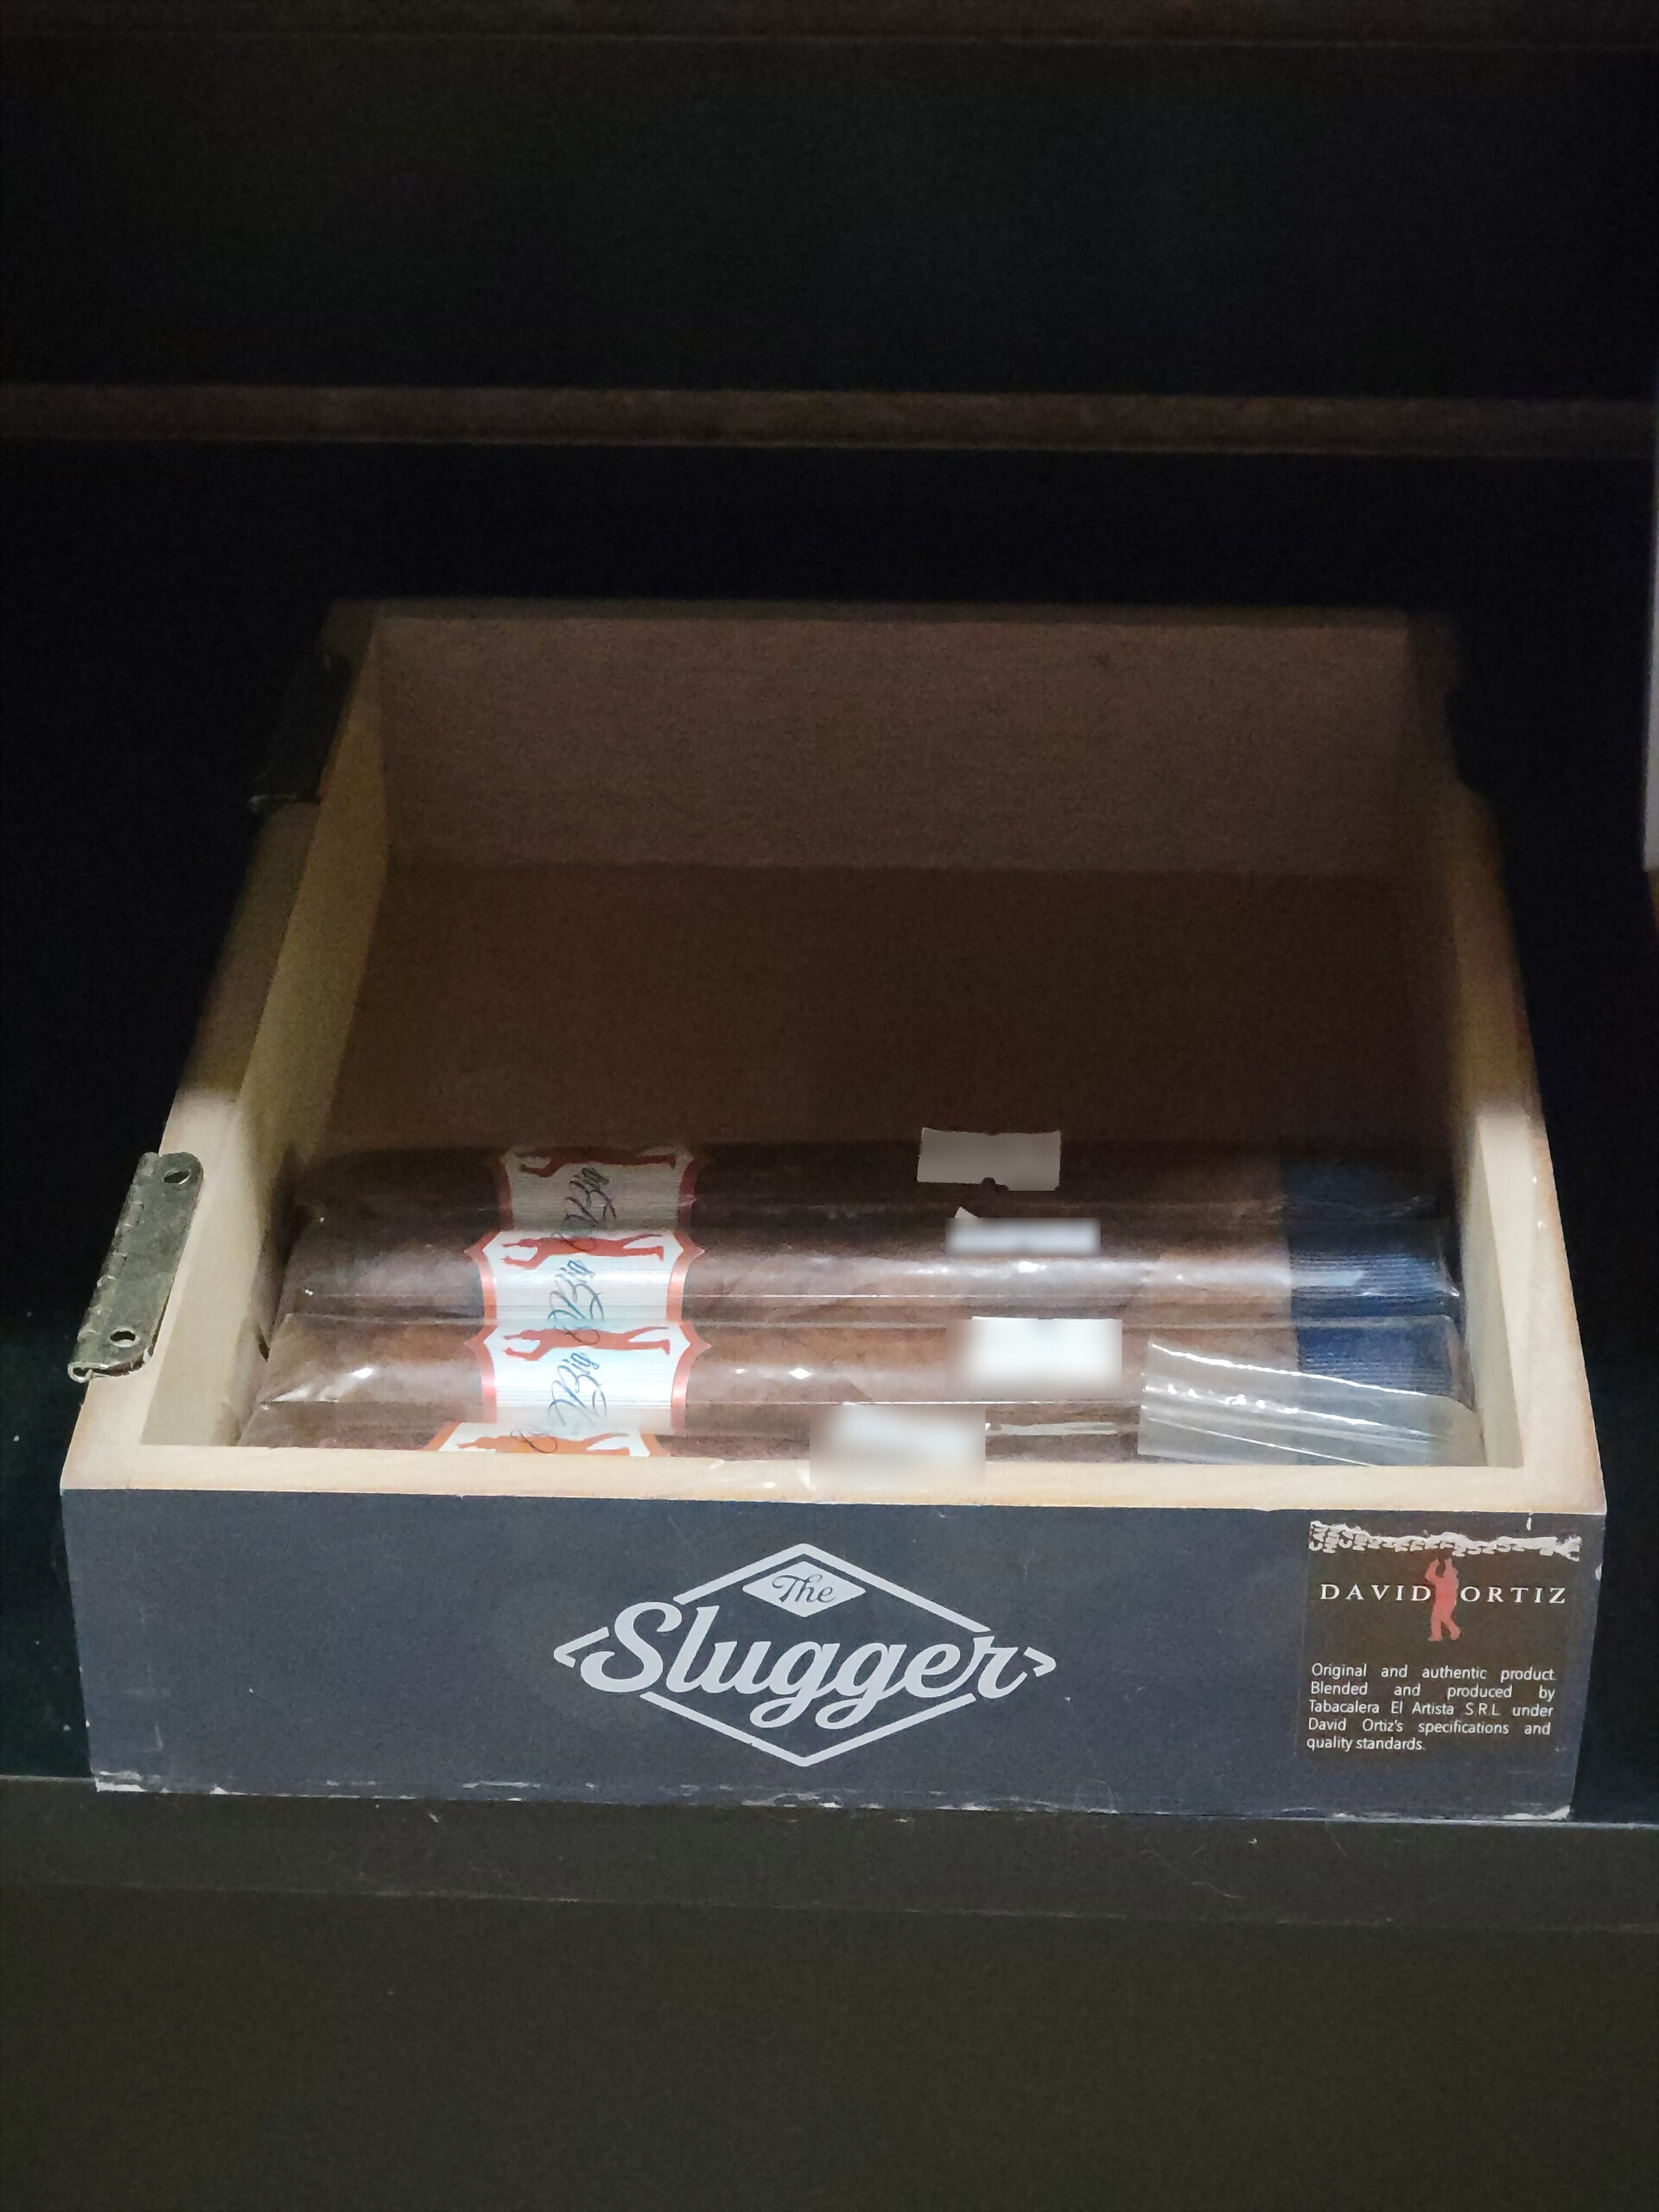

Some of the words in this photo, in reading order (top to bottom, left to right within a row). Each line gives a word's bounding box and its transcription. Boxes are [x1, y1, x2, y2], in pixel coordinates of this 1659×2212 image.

[772, 1573, 836, 1603] The
[1320, 1584, 1432, 1601] DAVID
[1460, 1586, 1567, 1604] ORTIZ
[580, 1601, 1027, 1730] Slugger
[1312, 1662, 1367, 1680] Original
[1381, 1664, 1408, 1678] and
[1421, 1665, 1487, 1680] authentic
[1311, 1681, 1368, 1695] Blended
[1394, 1682, 1421, 1696] and
[1446, 1683, 1513, 1700] produced
[1538, 1685, 1555, 1702] by
[1309, 1699, 1380, 1713] Tabacalera
[1390, 1700, 1403, 1714] El
[1411, 1701, 1454, 1715] Artista
[1512, 1703, 1554, 1717] under
[1308, 1717, 1347, 1731] David
[1362, 1718, 1404, 1732] Ortiz's
[1418, 1719, 1510, 1736] specifications
[1523, 1721, 1551, 1736] and
[1306, 1735, 1352, 1752] quality
